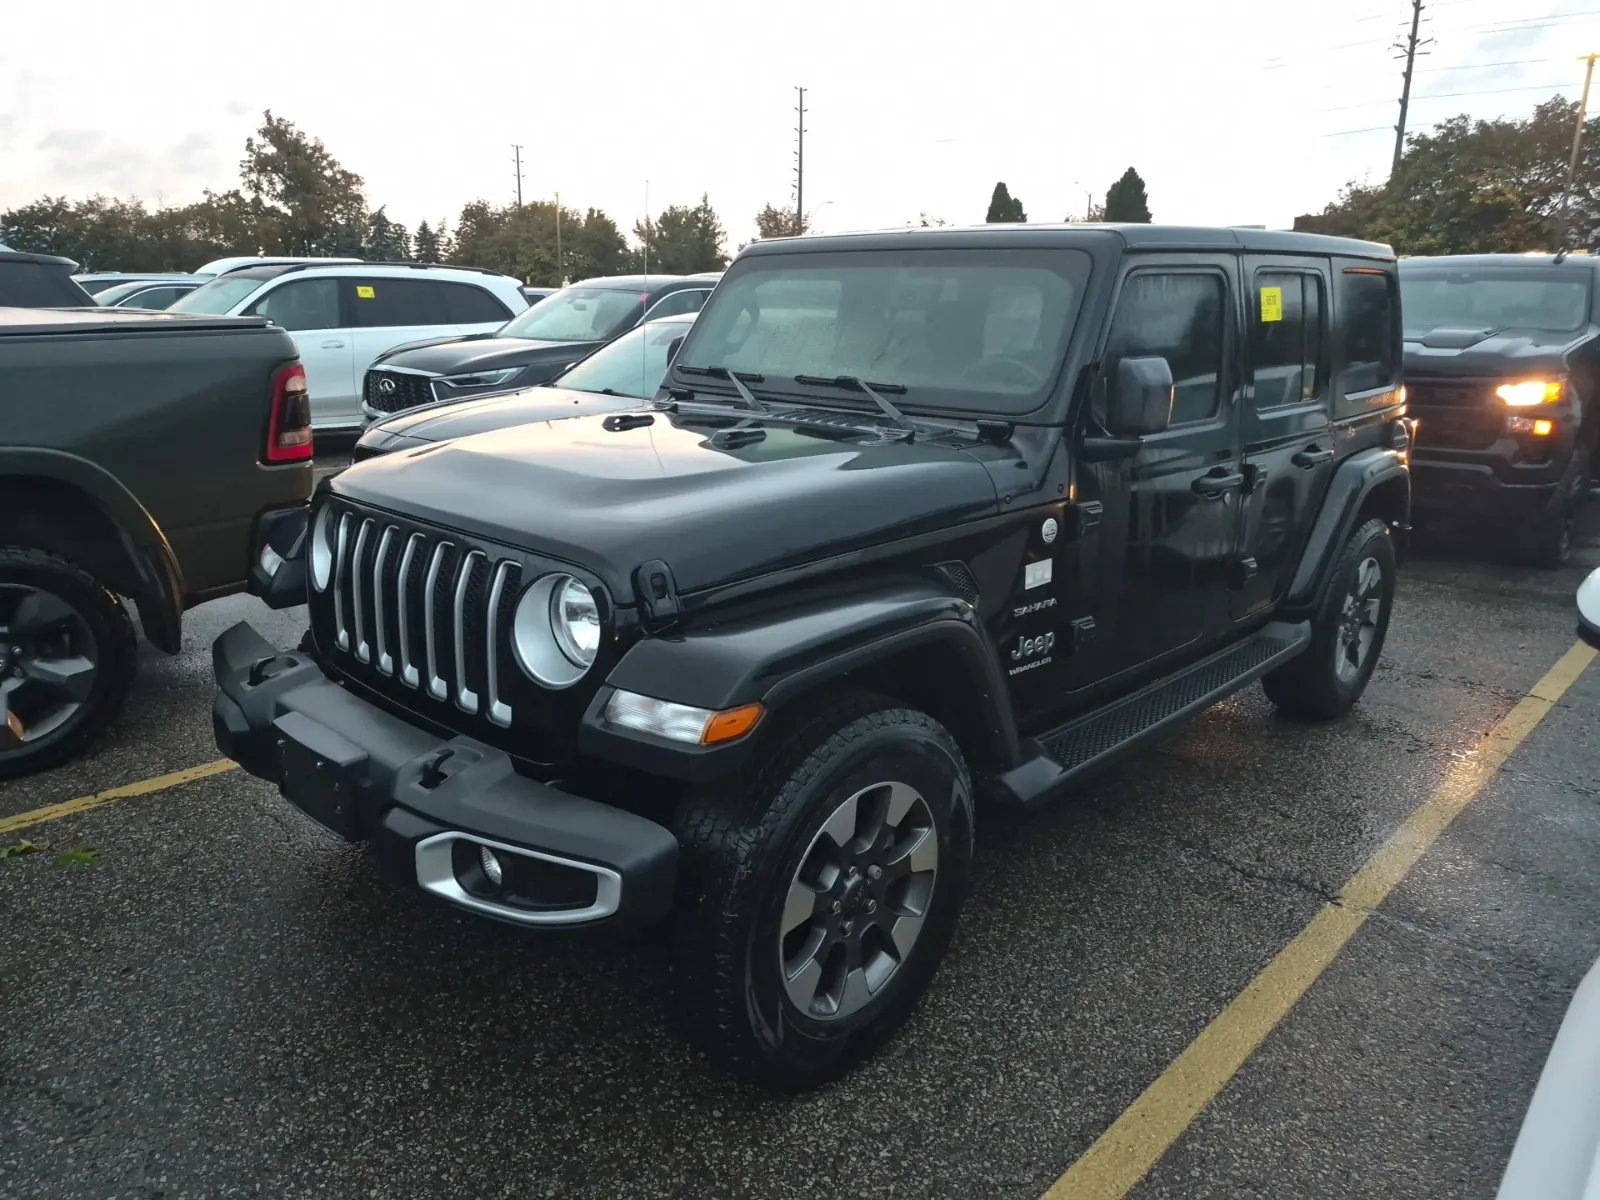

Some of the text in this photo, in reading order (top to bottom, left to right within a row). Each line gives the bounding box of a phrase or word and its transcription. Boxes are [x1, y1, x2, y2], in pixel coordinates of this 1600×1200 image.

[1013, 598, 1058, 617] SAHARA
[1011, 631, 1055, 660] Jeep
[1009, 656, 1052, 676] WRANGLER
